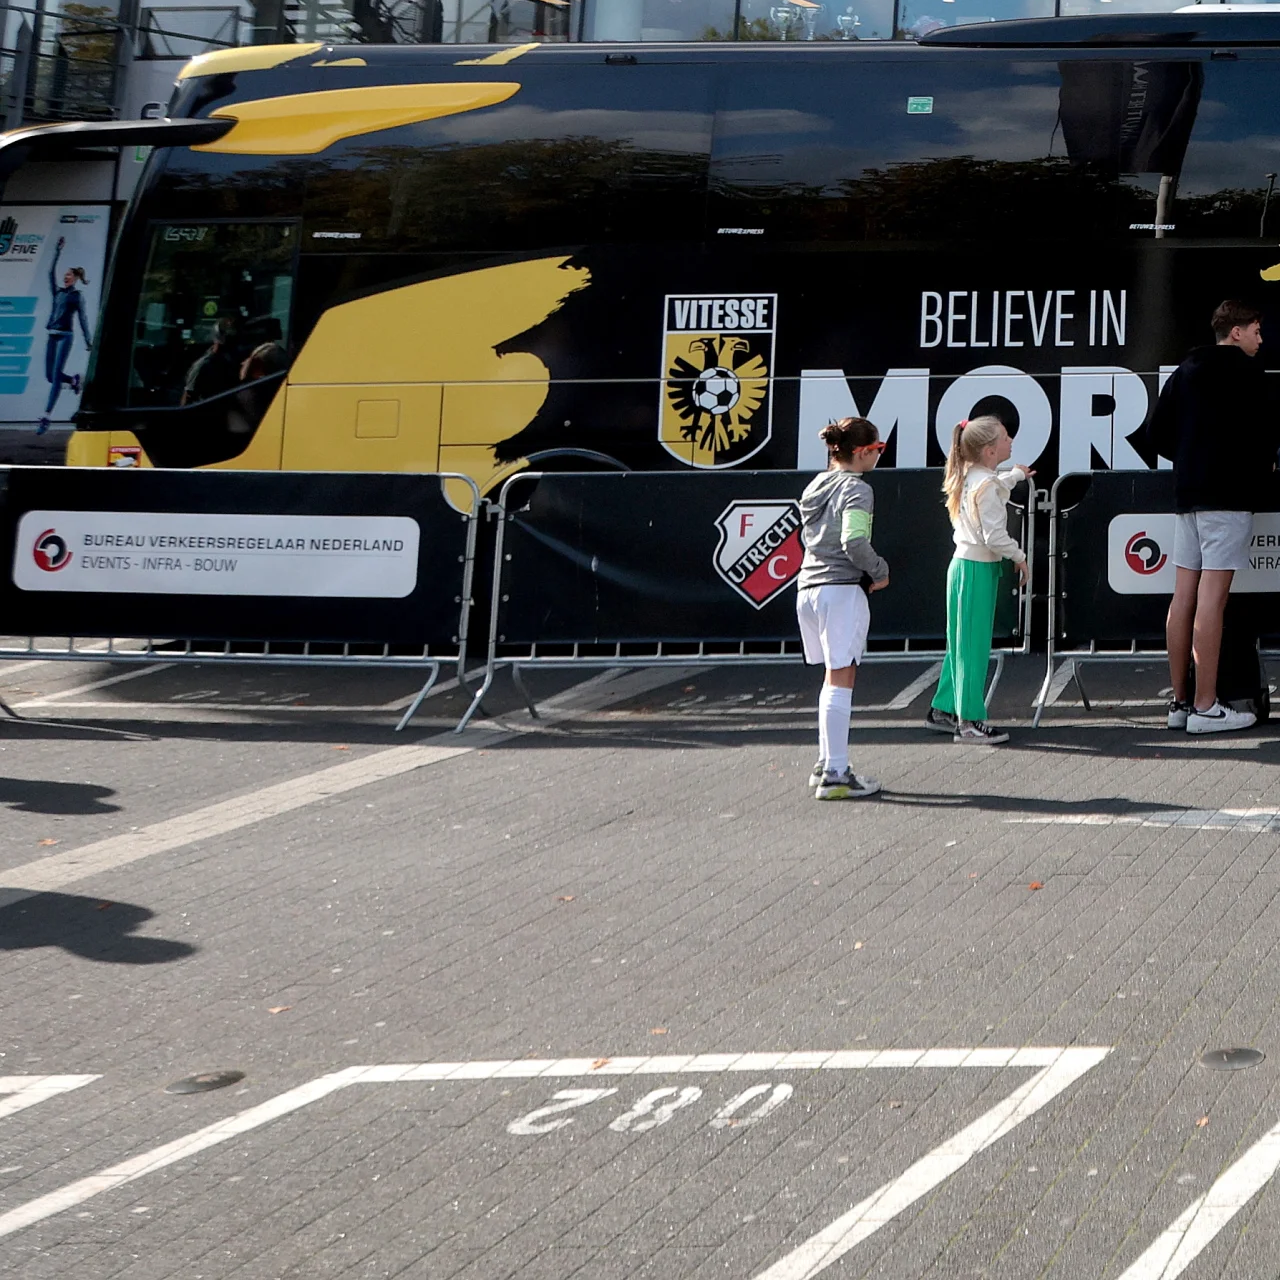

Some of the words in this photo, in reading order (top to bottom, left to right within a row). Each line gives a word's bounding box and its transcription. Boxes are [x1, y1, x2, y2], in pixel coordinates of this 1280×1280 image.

[11, 245, 38, 255] FIVE
[674, 298, 769, 329] VITESSE
[919, 290, 1075, 348] BELIEVE
[1088, 289, 1127, 347] IN
[797, 364, 1180, 475] MOR
[739, 513, 755, 538] F
[84, 534, 145, 549] BUREAU
[149, 535, 306, 552] VERKEERSREGELAAR
[309, 538, 404, 552] NEDERLAND
[727, 509, 800, 584] UTRECHT
[81, 556, 132, 570] EVENTS
[142, 557, 183, 571] INFRA
[194, 558, 238, 572] BOUW
[767, 555, 788, 580] C
